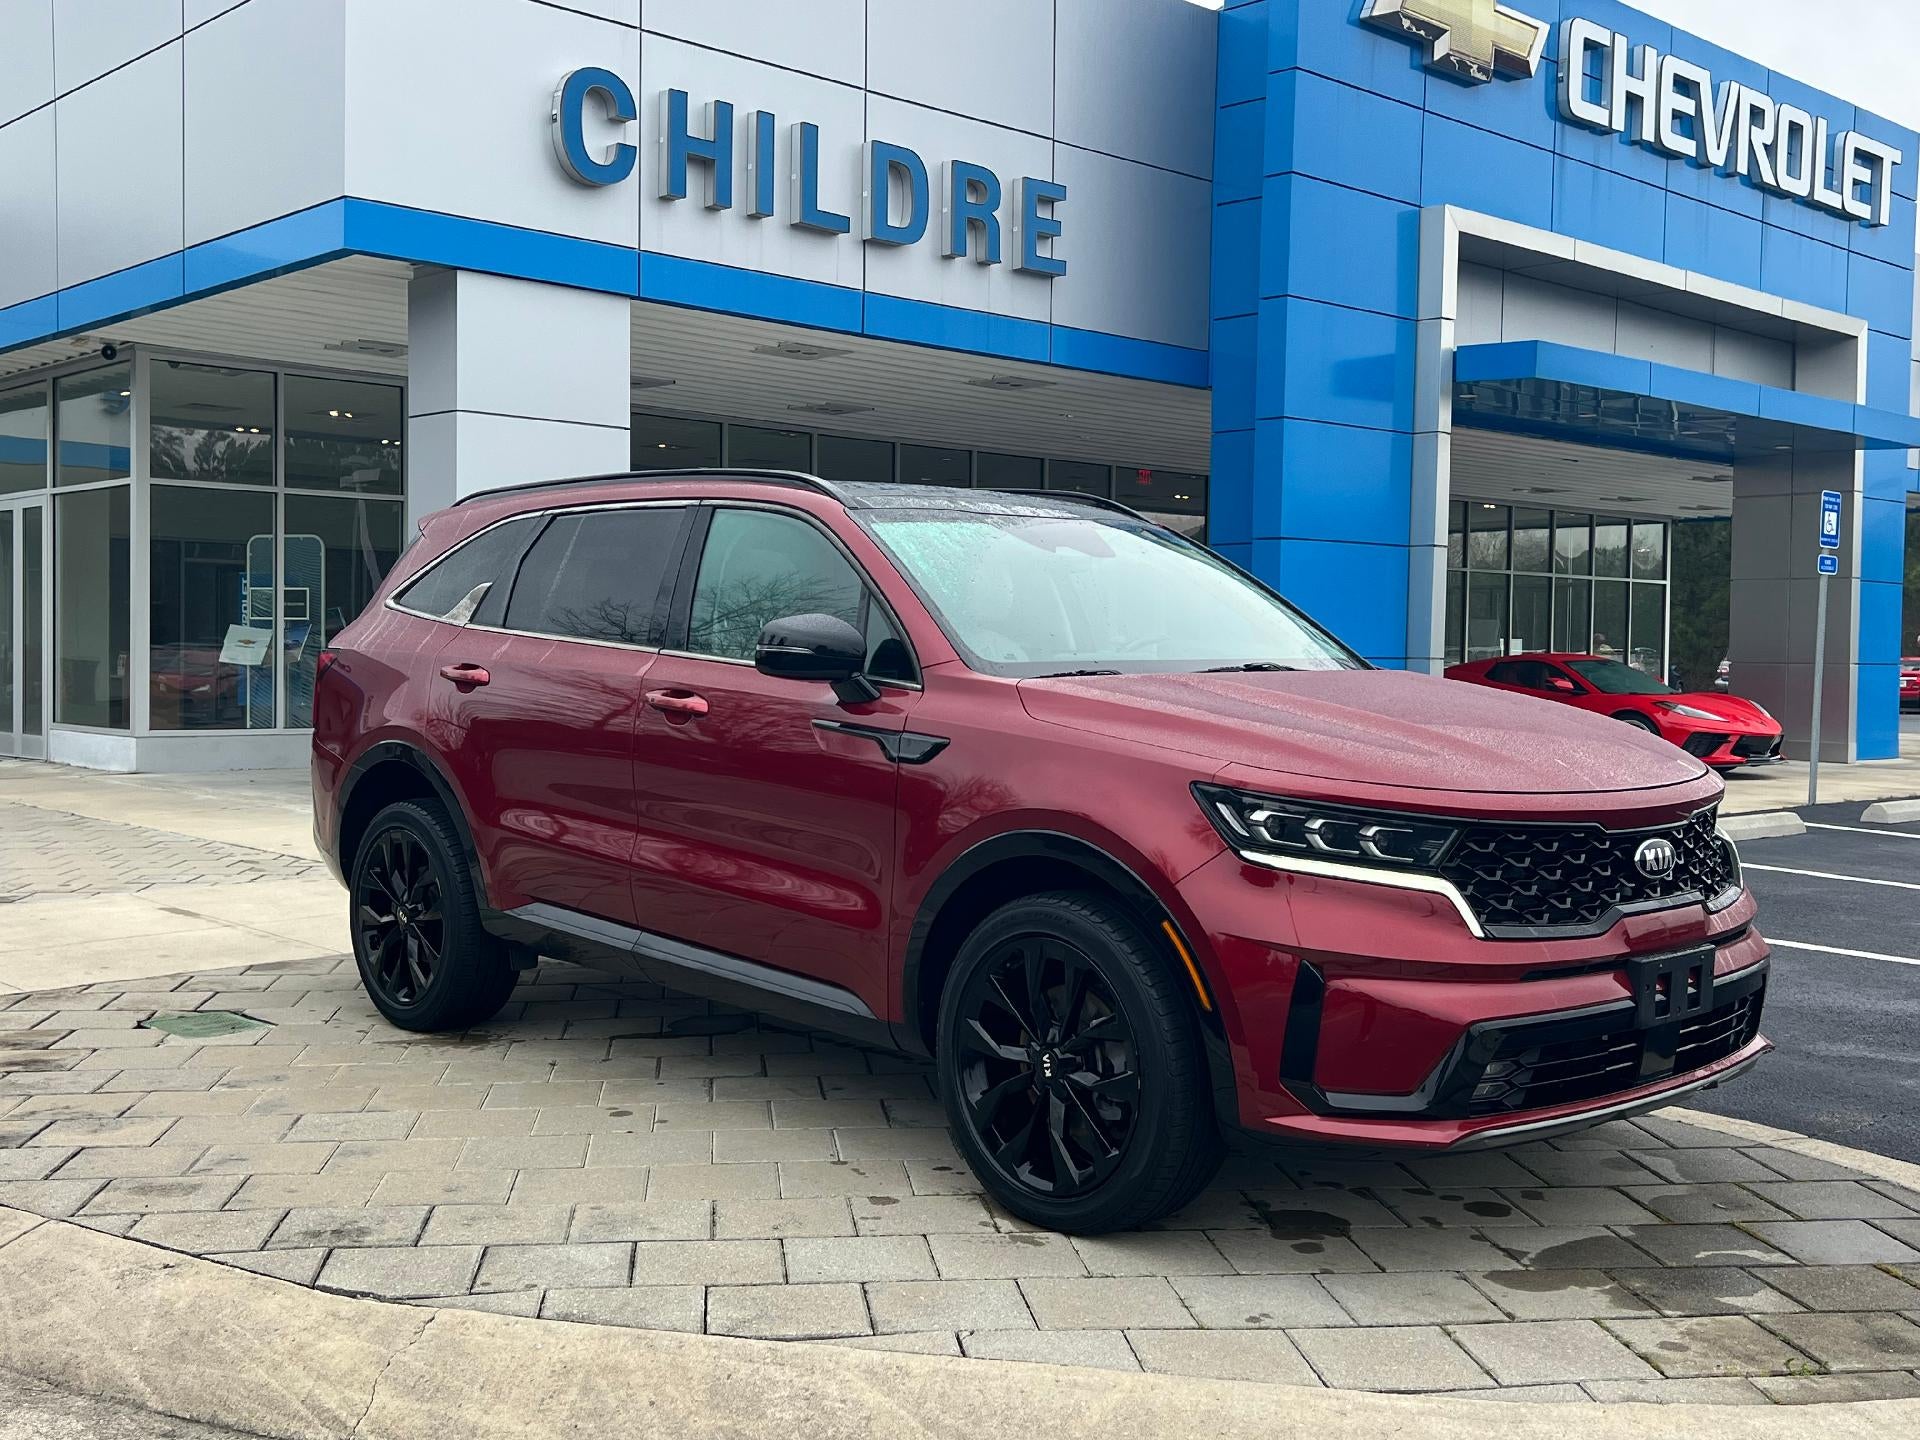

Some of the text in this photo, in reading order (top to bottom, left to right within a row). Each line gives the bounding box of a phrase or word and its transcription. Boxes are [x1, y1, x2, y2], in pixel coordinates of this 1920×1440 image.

[552, 67, 1067, 277] CHILDRE
[1559, 17, 1902, 227] CHEVROLET
[1643, 846, 1673, 871] KIA
[1042, 1053, 1052, 1078] KIA
